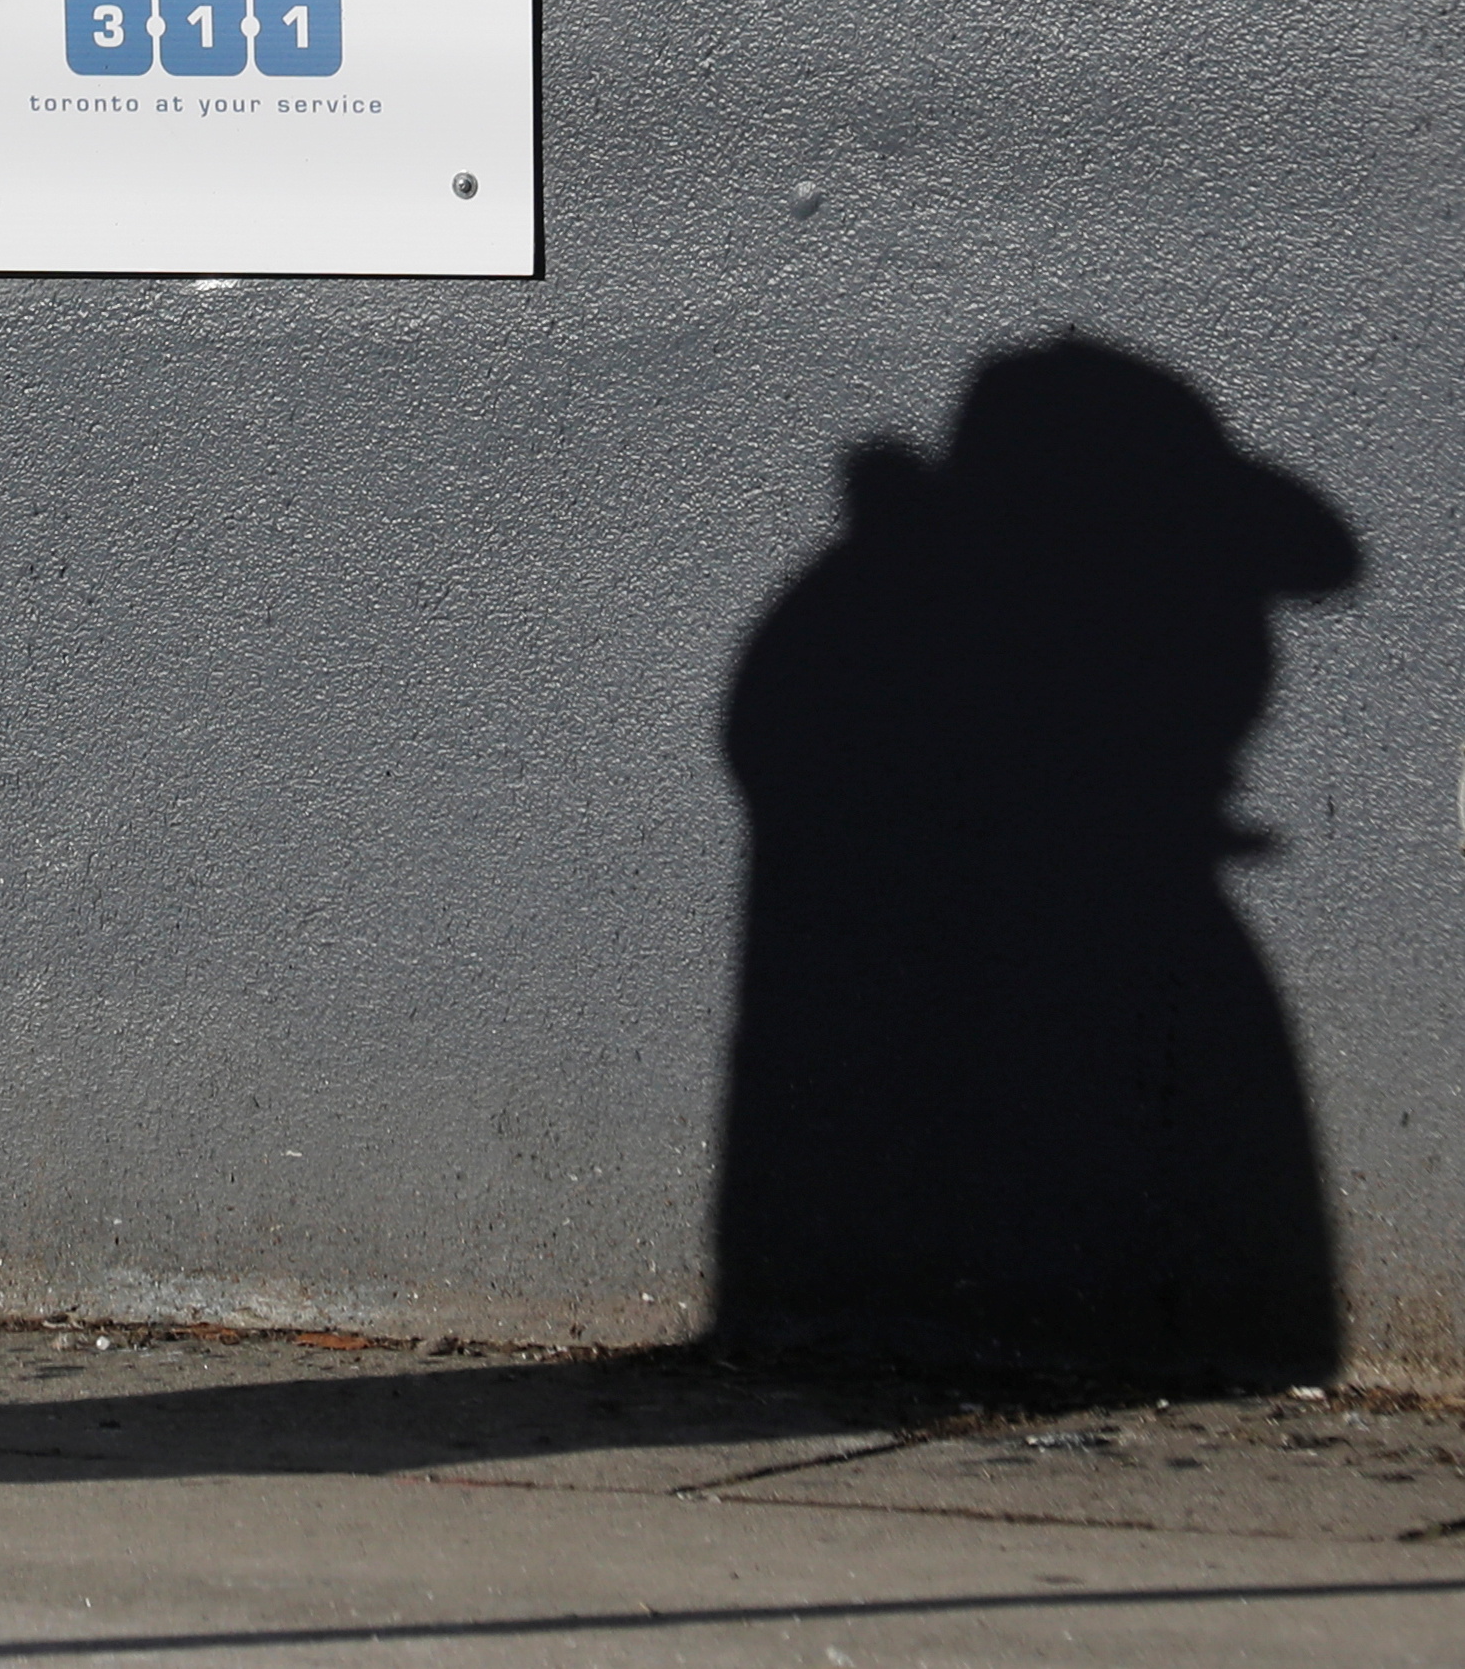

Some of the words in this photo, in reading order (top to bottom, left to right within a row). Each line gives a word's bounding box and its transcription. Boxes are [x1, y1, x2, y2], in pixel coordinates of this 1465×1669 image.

[28, 94, 140, 113] toronto
[156, 94, 185, 113] at
[198, 98, 262, 117] your
[277, 94, 384, 113] service
